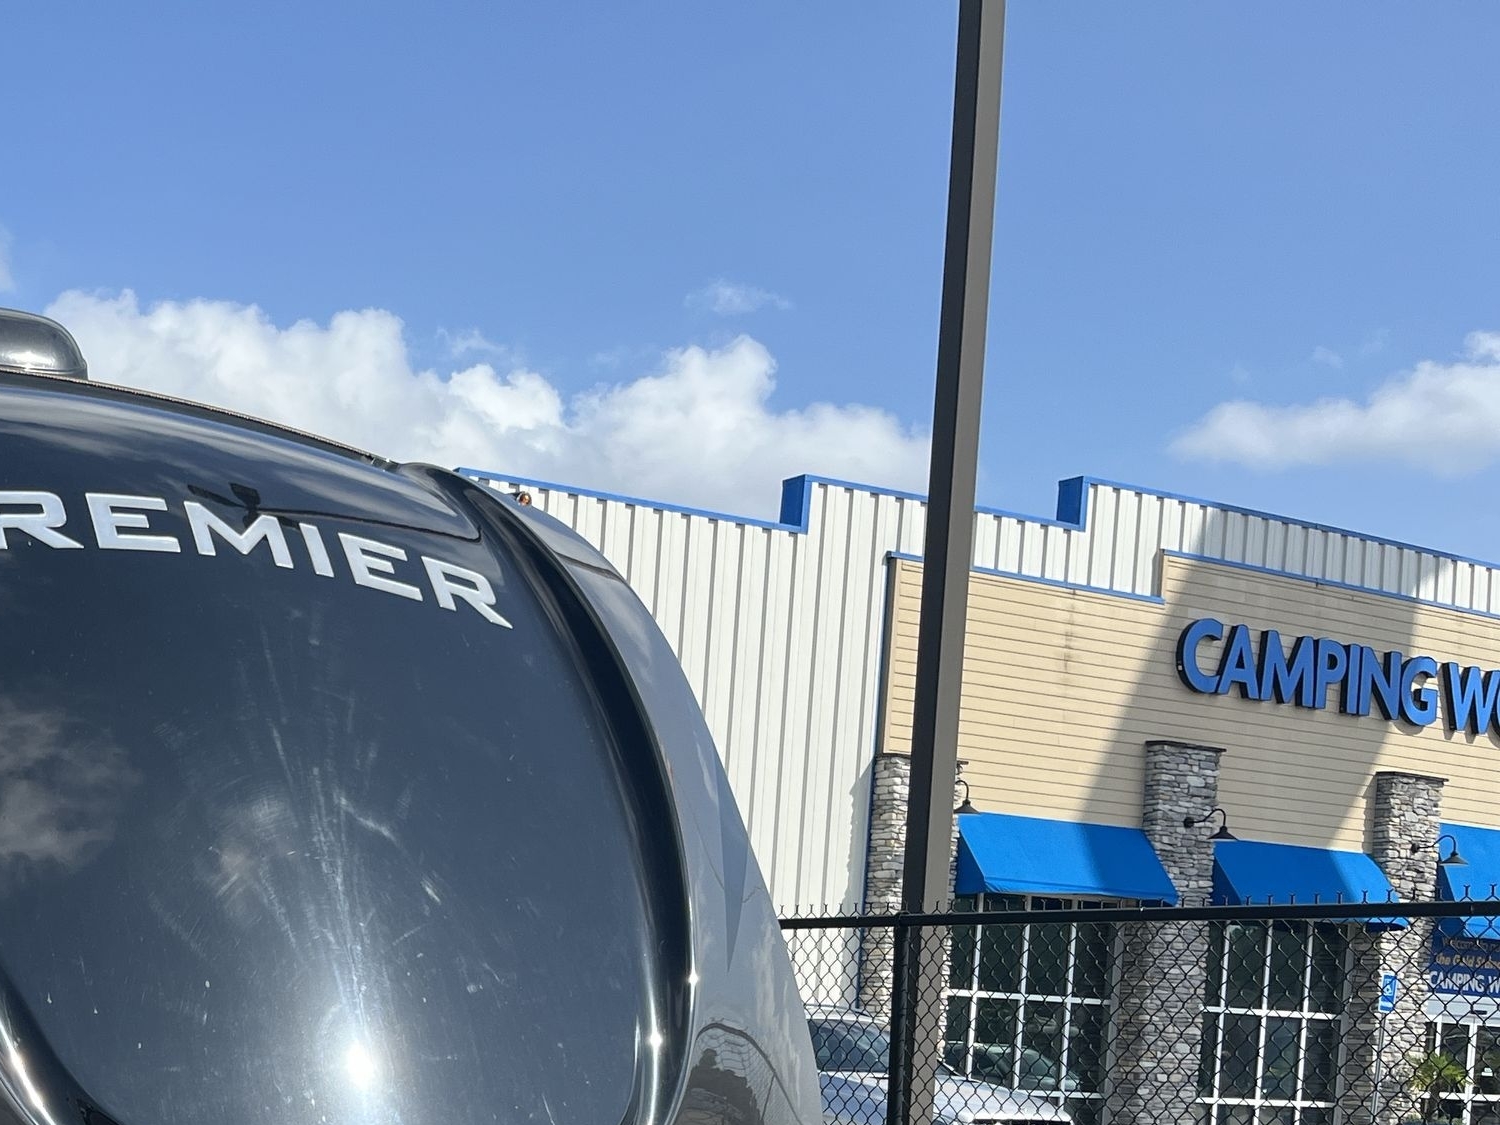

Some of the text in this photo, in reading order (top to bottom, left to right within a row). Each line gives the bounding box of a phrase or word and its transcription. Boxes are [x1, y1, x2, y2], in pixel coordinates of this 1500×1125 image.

[1176, 617, 1500, 735] CAMPING W
[1429, 971, 1485, 993] CAMPING
